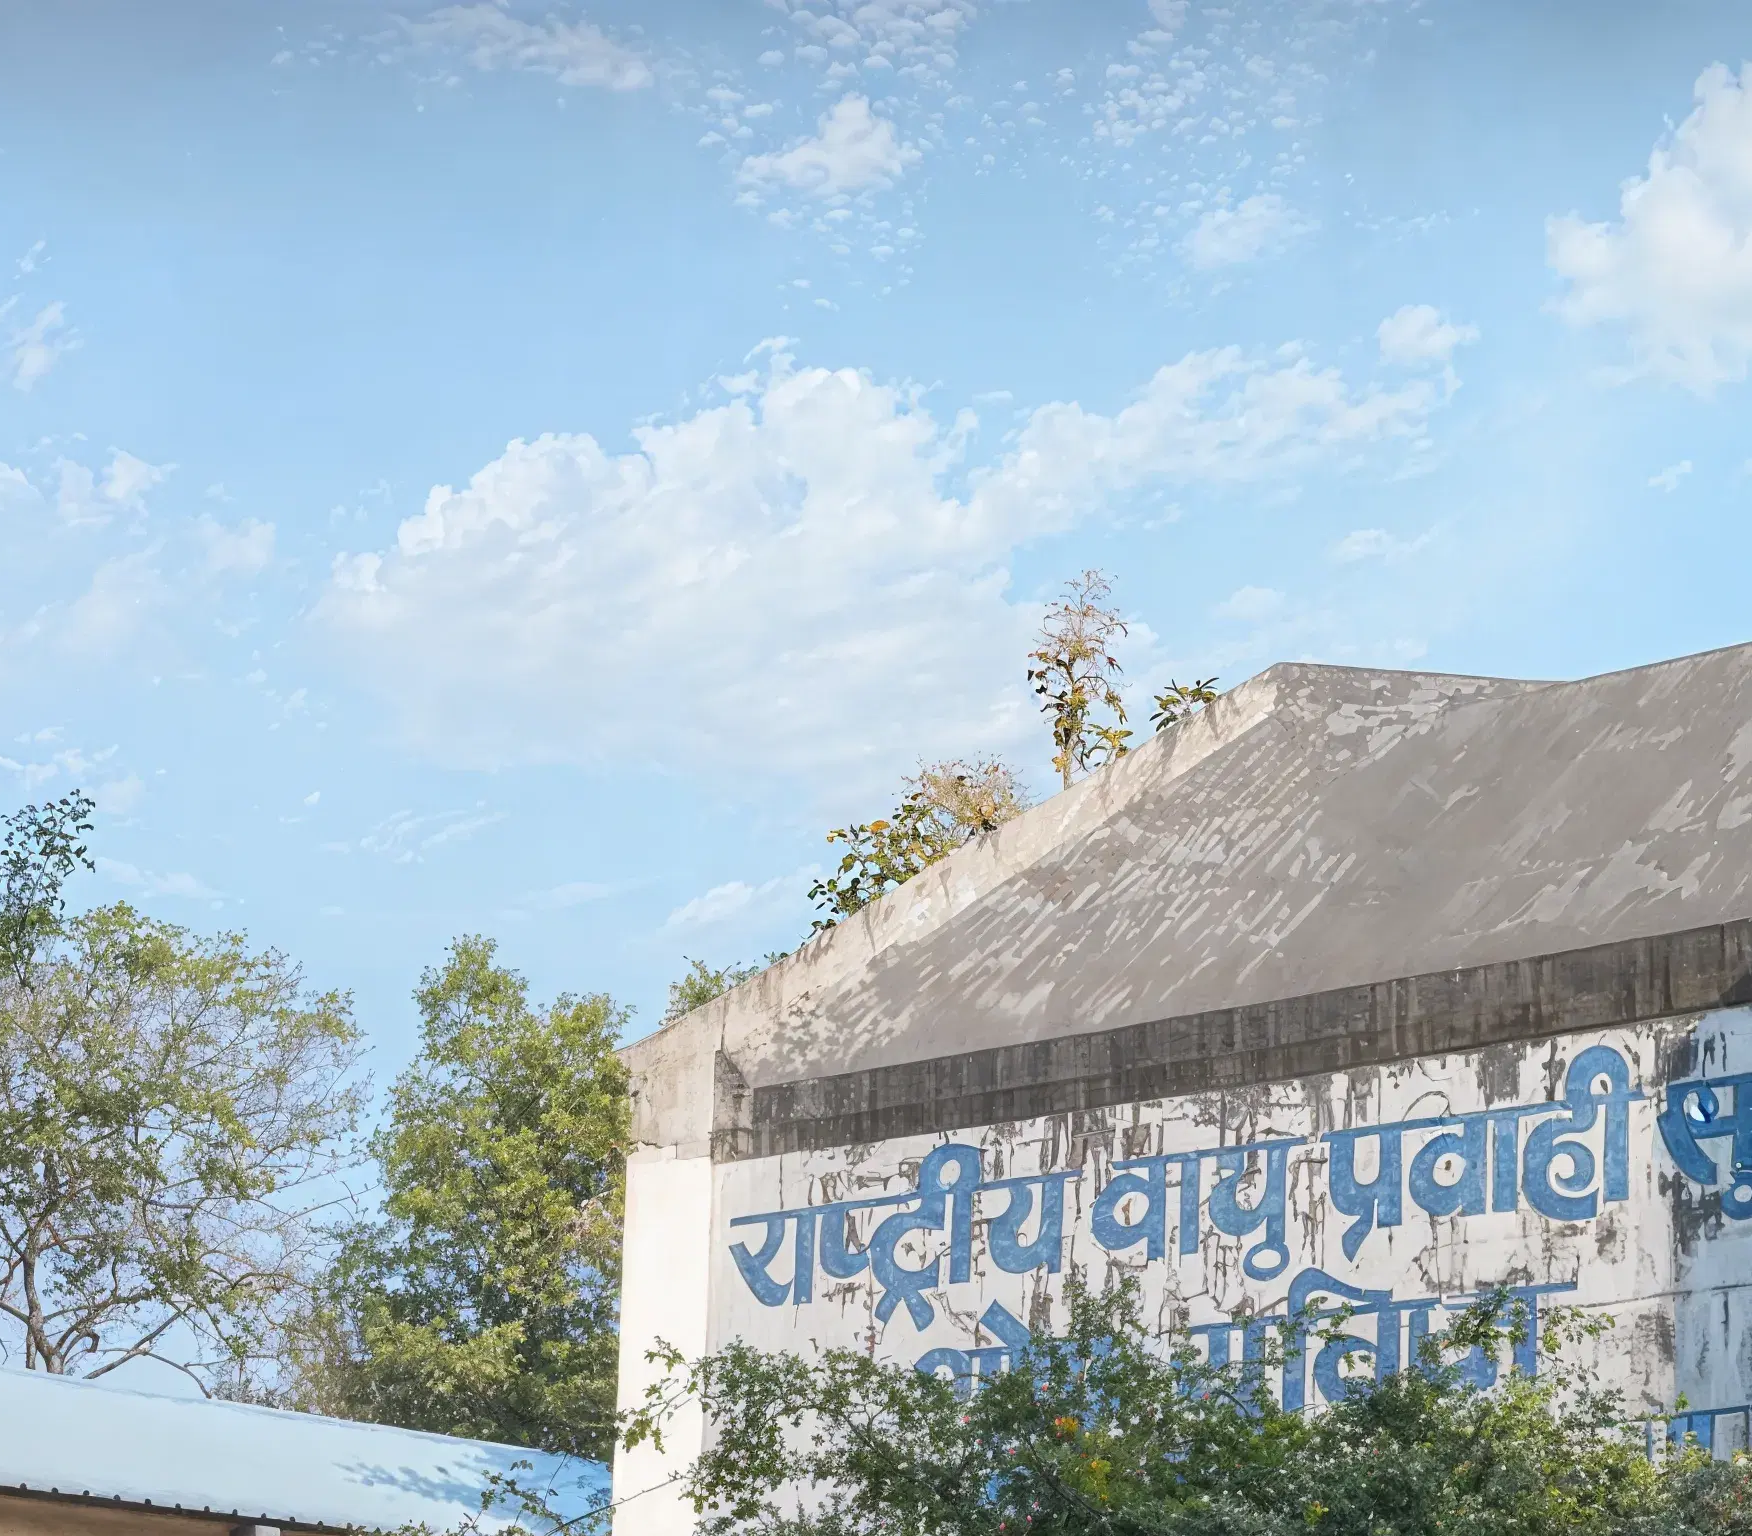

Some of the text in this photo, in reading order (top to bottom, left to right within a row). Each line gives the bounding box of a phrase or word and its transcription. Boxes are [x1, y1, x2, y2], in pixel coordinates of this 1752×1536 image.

[730, 1142, 1083, 1332] राष्ट्रीय
[1090, 1136, 1308, 1282] वायु
[1321, 1044, 1648, 1263] प्रवाही
